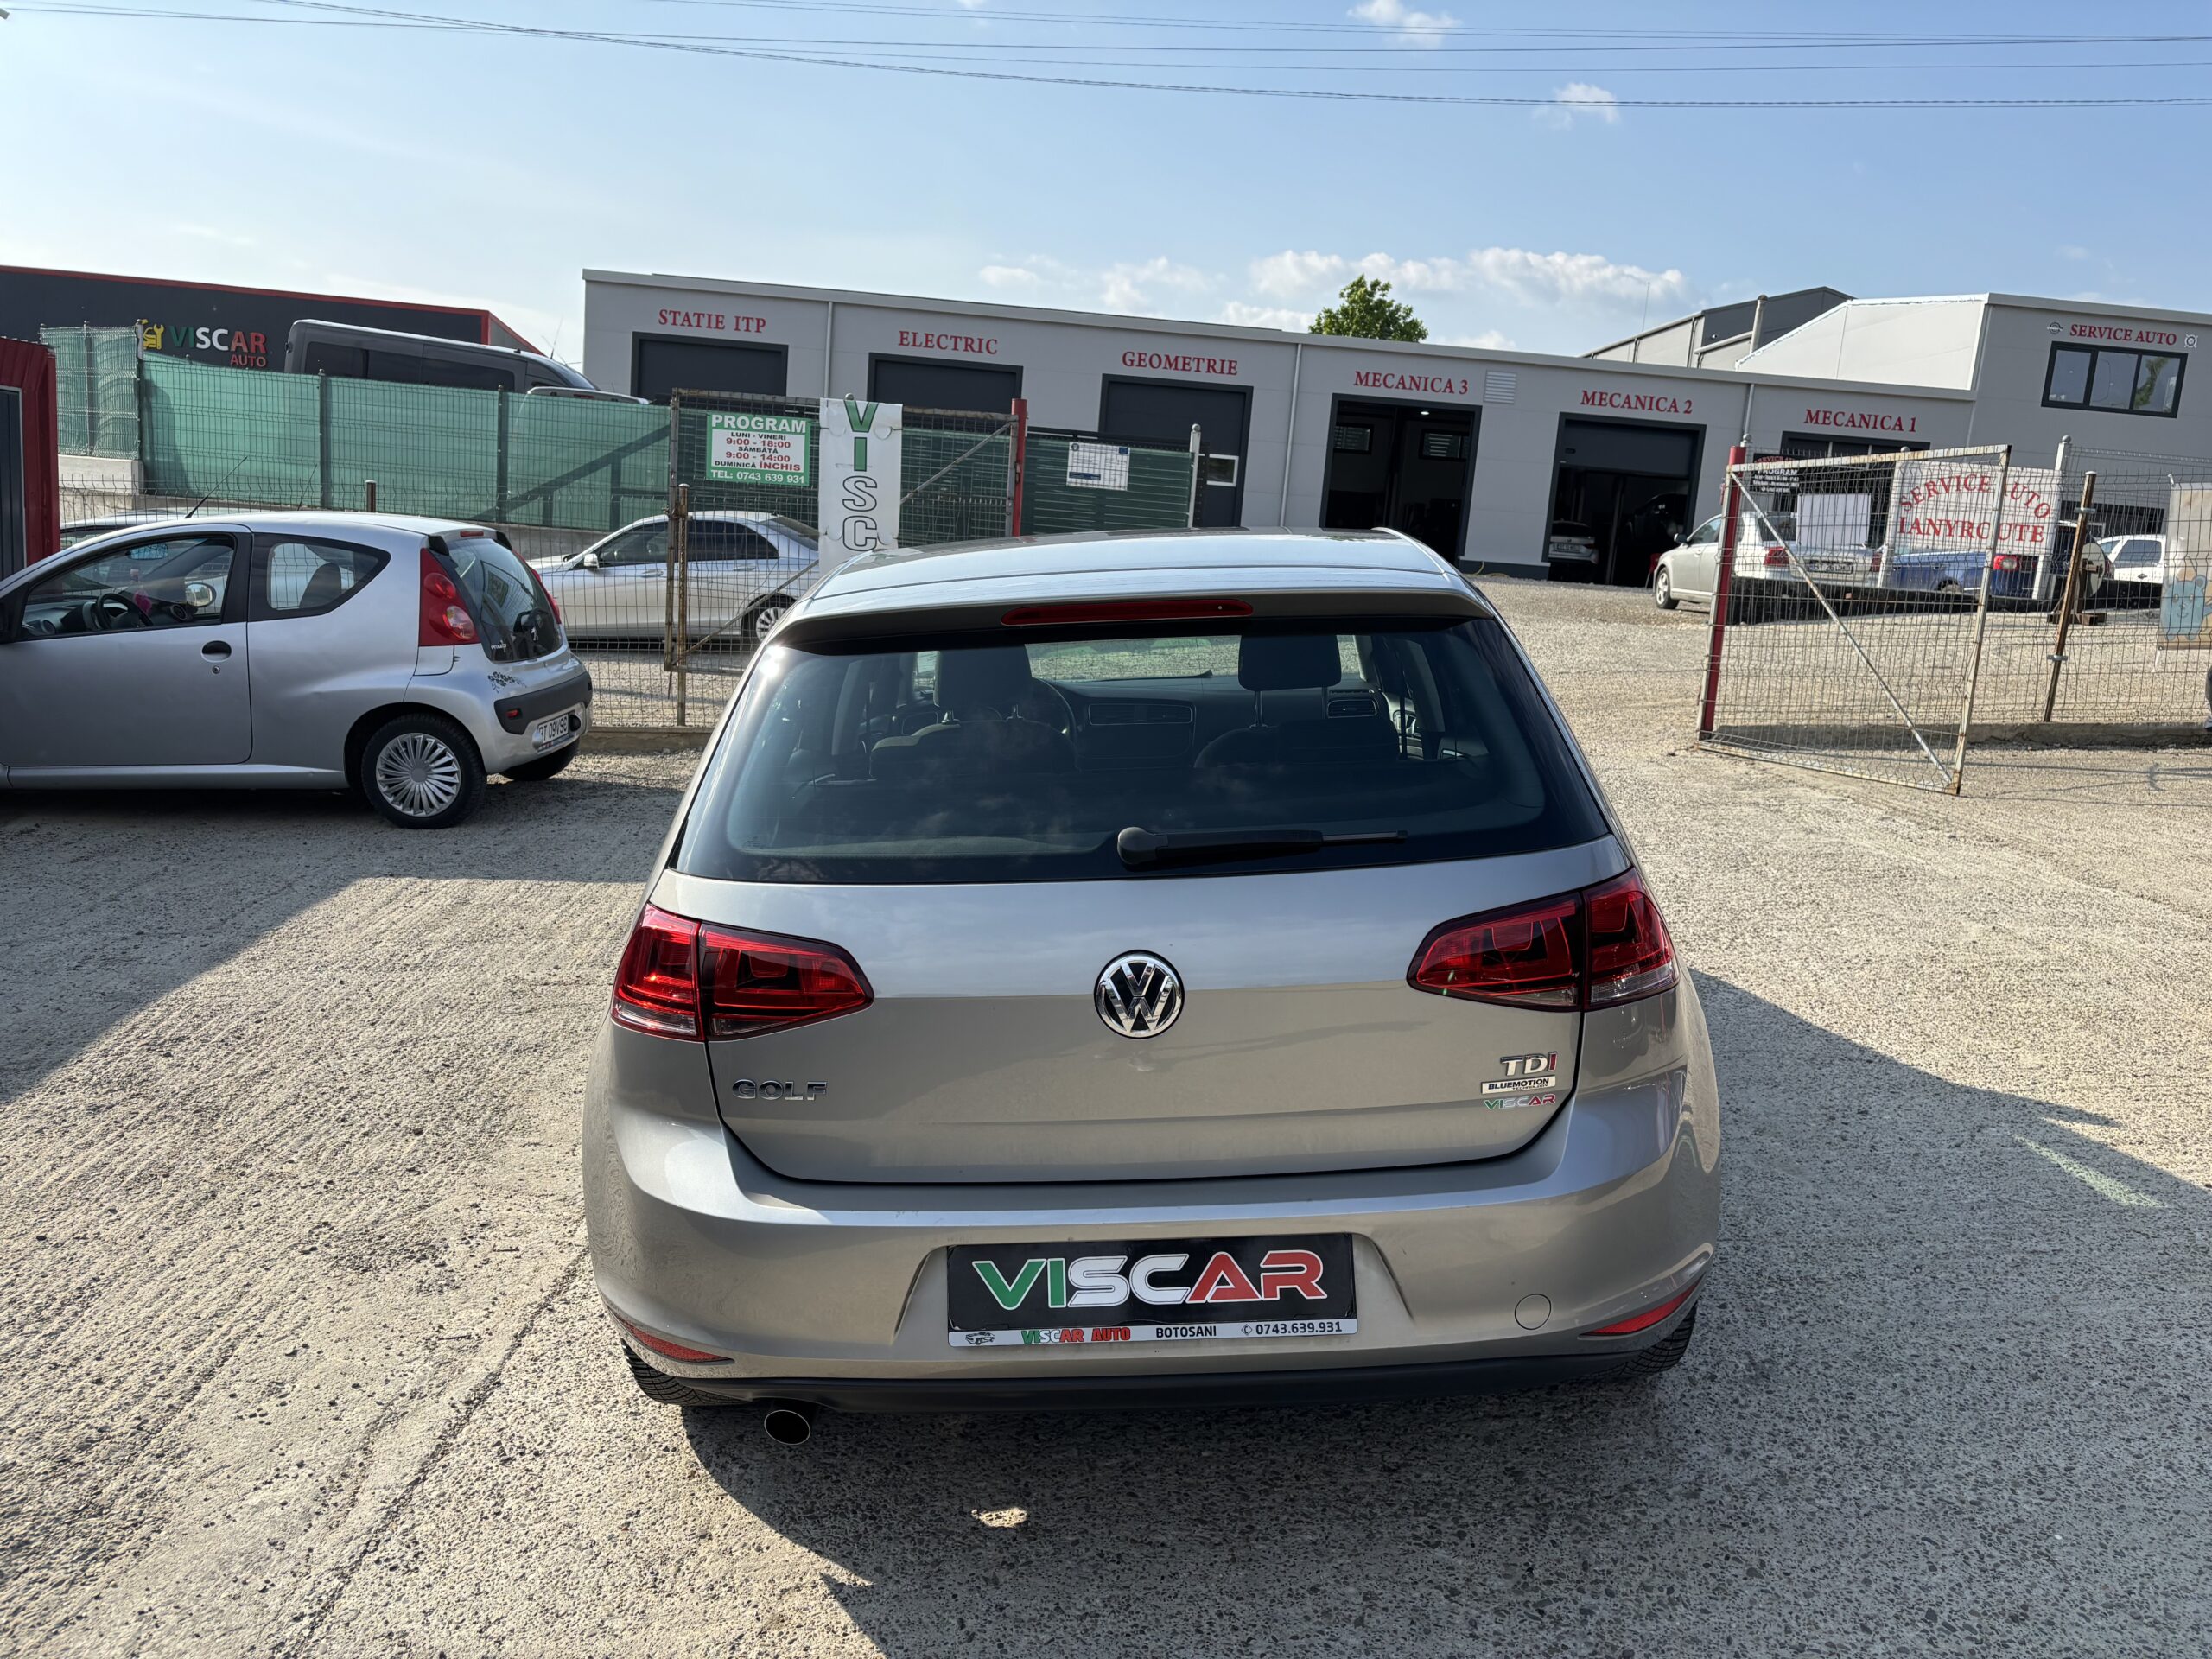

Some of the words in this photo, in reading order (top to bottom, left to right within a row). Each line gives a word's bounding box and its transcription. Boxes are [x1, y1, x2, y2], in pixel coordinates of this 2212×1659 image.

[658, 308, 726, 330] STATIE
[734, 315, 766, 334] ITP
[169, 325, 266, 354] VISCAR
[899, 330, 998, 354] ELECTRIC
[2069, 324, 2133, 341] SERVICE
[2135, 331, 2177, 346] AUTO
[230, 354, 266, 368] AUTO
[1122, 351, 1238, 376] GEOMETRIE
[1353, 371, 1454, 394] MECANICA
[1459, 378, 1469, 395] 3
[1580, 390, 1679, 413] MECANICA
[1683, 399, 1693, 415] 2
[711, 414, 806, 433] PROGRAM
[1803, 409, 1904, 432] MECANICA
[1910, 416, 1917, 432] 1
[726, 437, 750, 446] 9:00
[760, 440, 791, 448] 18:00
[725, 451, 750, 460] 9:00
[760, 454, 791, 462] 14:00
[759, 460, 801, 472] ÎNCHIS
[710, 469, 734, 479] TEL:
[736, 471, 761, 481] 0743
[764, 473, 784, 483] 639
[786, 474, 805, 484] 931
[1900, 474, 1992, 512] SERVICE
[2001, 480, 2051, 518] UTO
[1500, 1051, 1558, 1077] TDI
[732, 1078, 827, 1101] GOLF
[1488, 1077, 1549, 1090] BLUEMOTION
[1484, 1093, 1556, 1111] VISCAR
[971, 1250, 1328, 1311] VISCAR
[1020, 1328, 1085, 1344] VISCAR
[1091, 1326, 1131, 1342] AUTO
[1155, 1325, 1217, 1338] BOTOSANI
[1255, 1321, 1343, 1336] 0743.639.931
